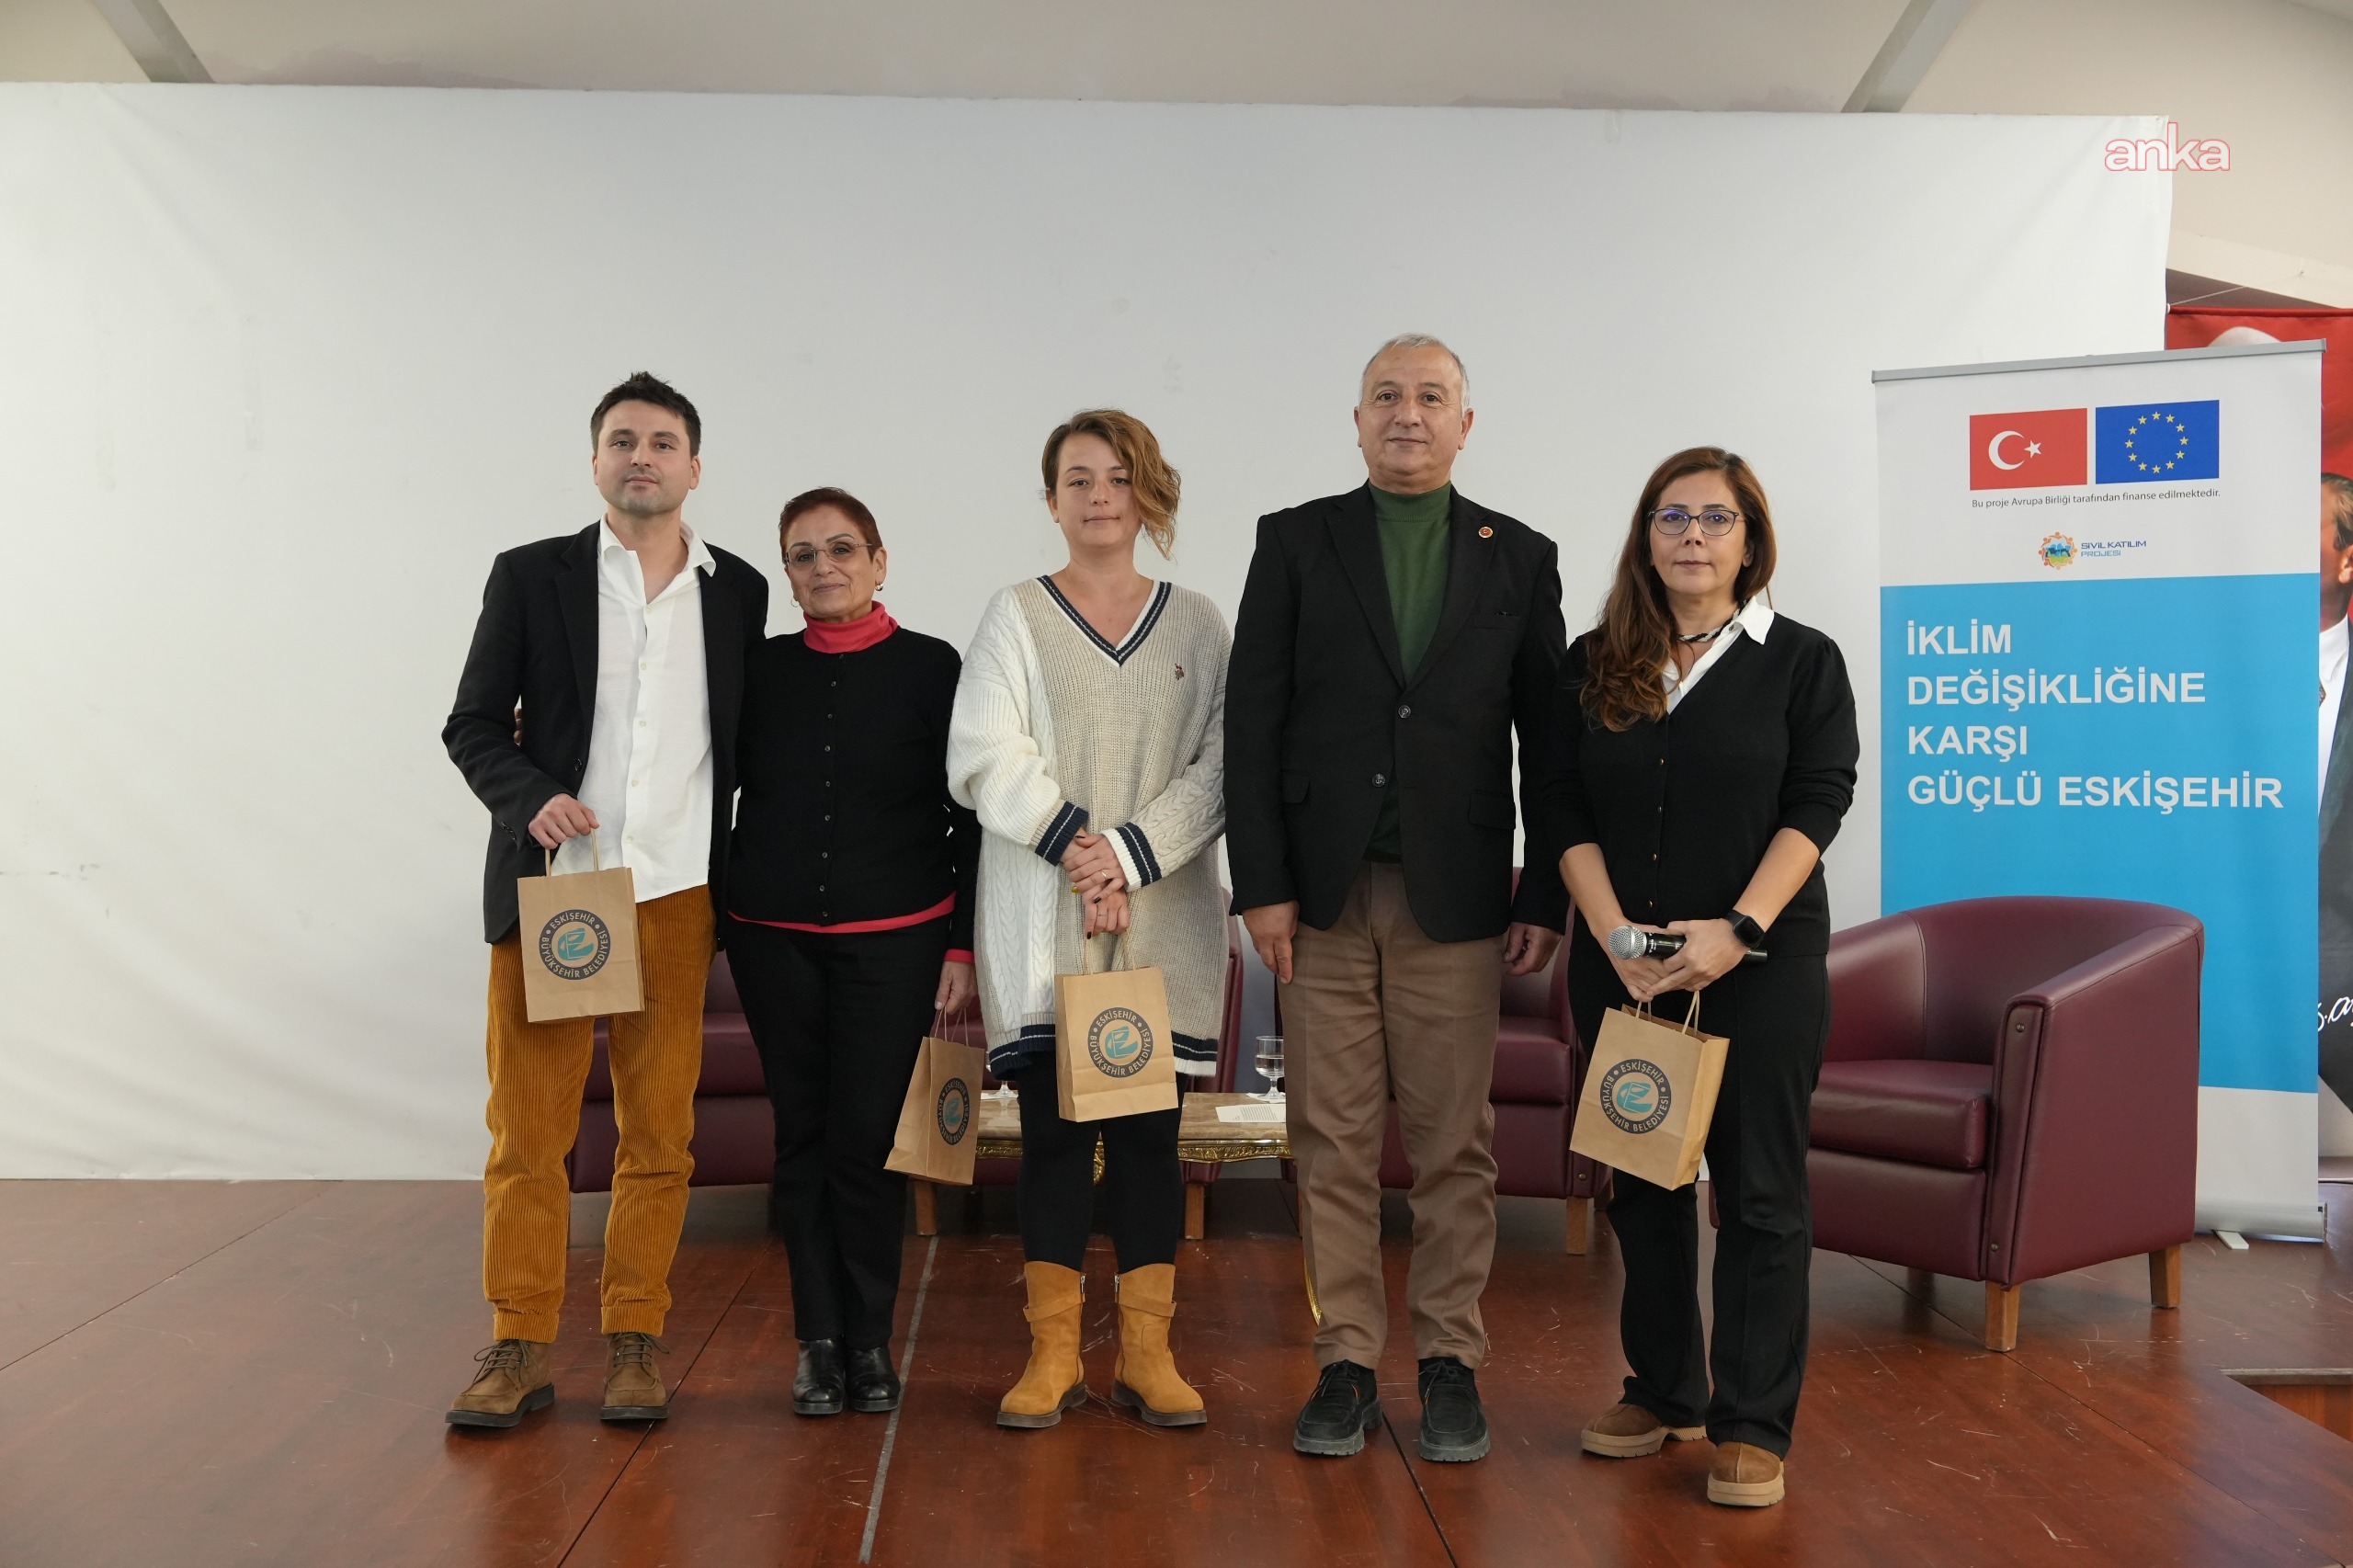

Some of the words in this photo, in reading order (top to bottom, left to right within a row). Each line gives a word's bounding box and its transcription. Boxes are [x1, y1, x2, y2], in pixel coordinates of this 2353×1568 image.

[1972, 499, 1984, 507] Bu
[1985, 499, 2009, 509] proje
[2011, 497, 2043, 506] Avrupa
[2045, 495, 2071, 505] Birliği
[2073, 493, 2120, 503] tarafından
[2122, 492, 2157, 501] finanse
[2158, 488, 2221, 499] edilmektedir.
[2108, 540, 2147, 549] KATILIM
[1907, 619, 2012, 655] İKLİM
[1908, 666, 2207, 712] DEĞİŞİKLİĞİNE
[1908, 725, 2028, 763] KARŞI
[1907, 770, 2042, 812] GÜÇLÜ
[2059, 770, 2284, 815] ESKİŞEHİR
[551, 912, 596, 929] ESKİŞEHİR
[540, 937, 580, 978] BÜYÜKŞEHİR
[584, 929, 608, 976] BELEDİYESİ
[1096, 1010, 1137, 1028] ESKİŞEHİR
[1090, 1035, 1126, 1075] BÜYÜKŞEHİR
[1128, 1028, 1150, 1074] BELEDİYESİ
[1620, 1061, 1665, 1085] ESKİŞEHİR
[1602, 1075, 1630, 1131] BÜYÜKŞEHİR
[1632, 1095, 1669, 1132] BELEDİYESİ
